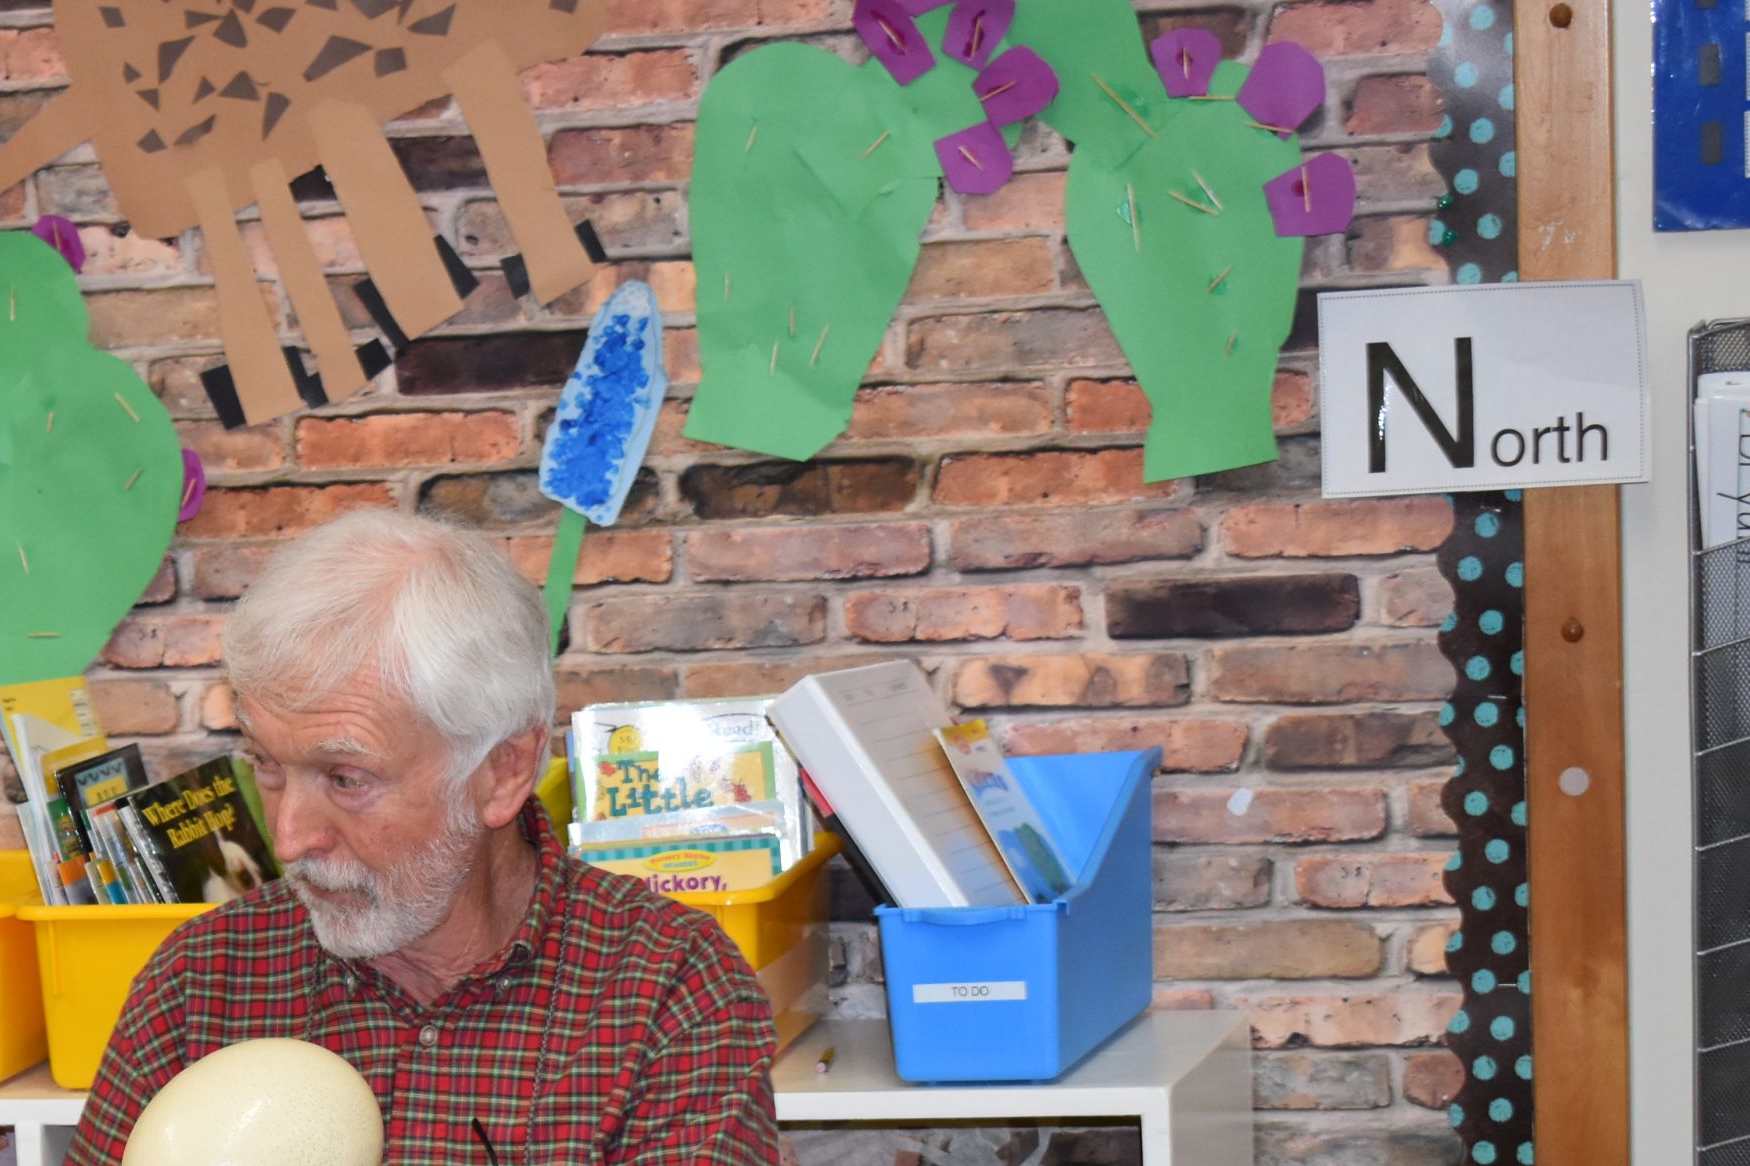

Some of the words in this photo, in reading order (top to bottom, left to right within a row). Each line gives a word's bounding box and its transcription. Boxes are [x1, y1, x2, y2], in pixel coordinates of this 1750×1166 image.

[1365, 336, 1610, 474] North
[141, 799, 187, 828] Where
[182, 789, 215, 811] Does
[212, 774, 236, 798] the
[606, 776, 715, 817] Little
[166, 816, 209, 849] Rabbit
[202, 802, 237, 832] Hop?
[951, 986, 969, 998] TO
[971, 985, 990, 997] DO
